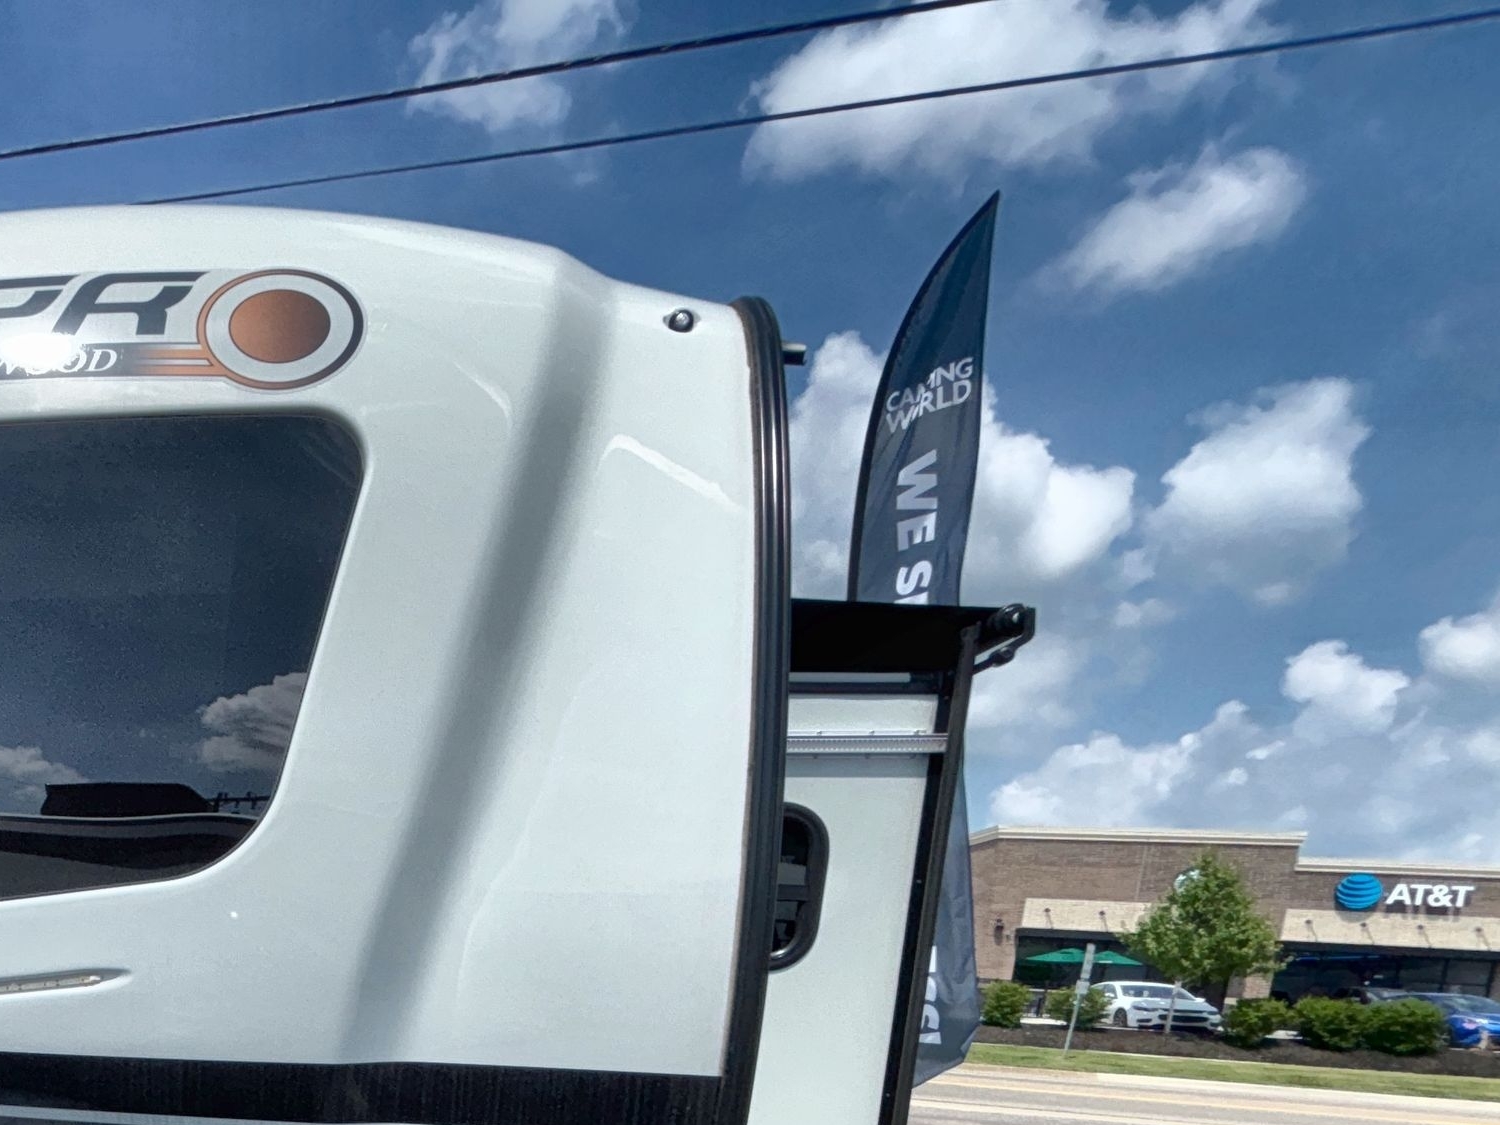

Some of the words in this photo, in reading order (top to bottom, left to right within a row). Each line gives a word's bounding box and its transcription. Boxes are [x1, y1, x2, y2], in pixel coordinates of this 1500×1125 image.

[885, 357, 974, 412] CAING
[885, 379, 972, 434] WRLD
[896, 449, 939, 551] WE
[1385, 883, 1475, 908] AT&T
